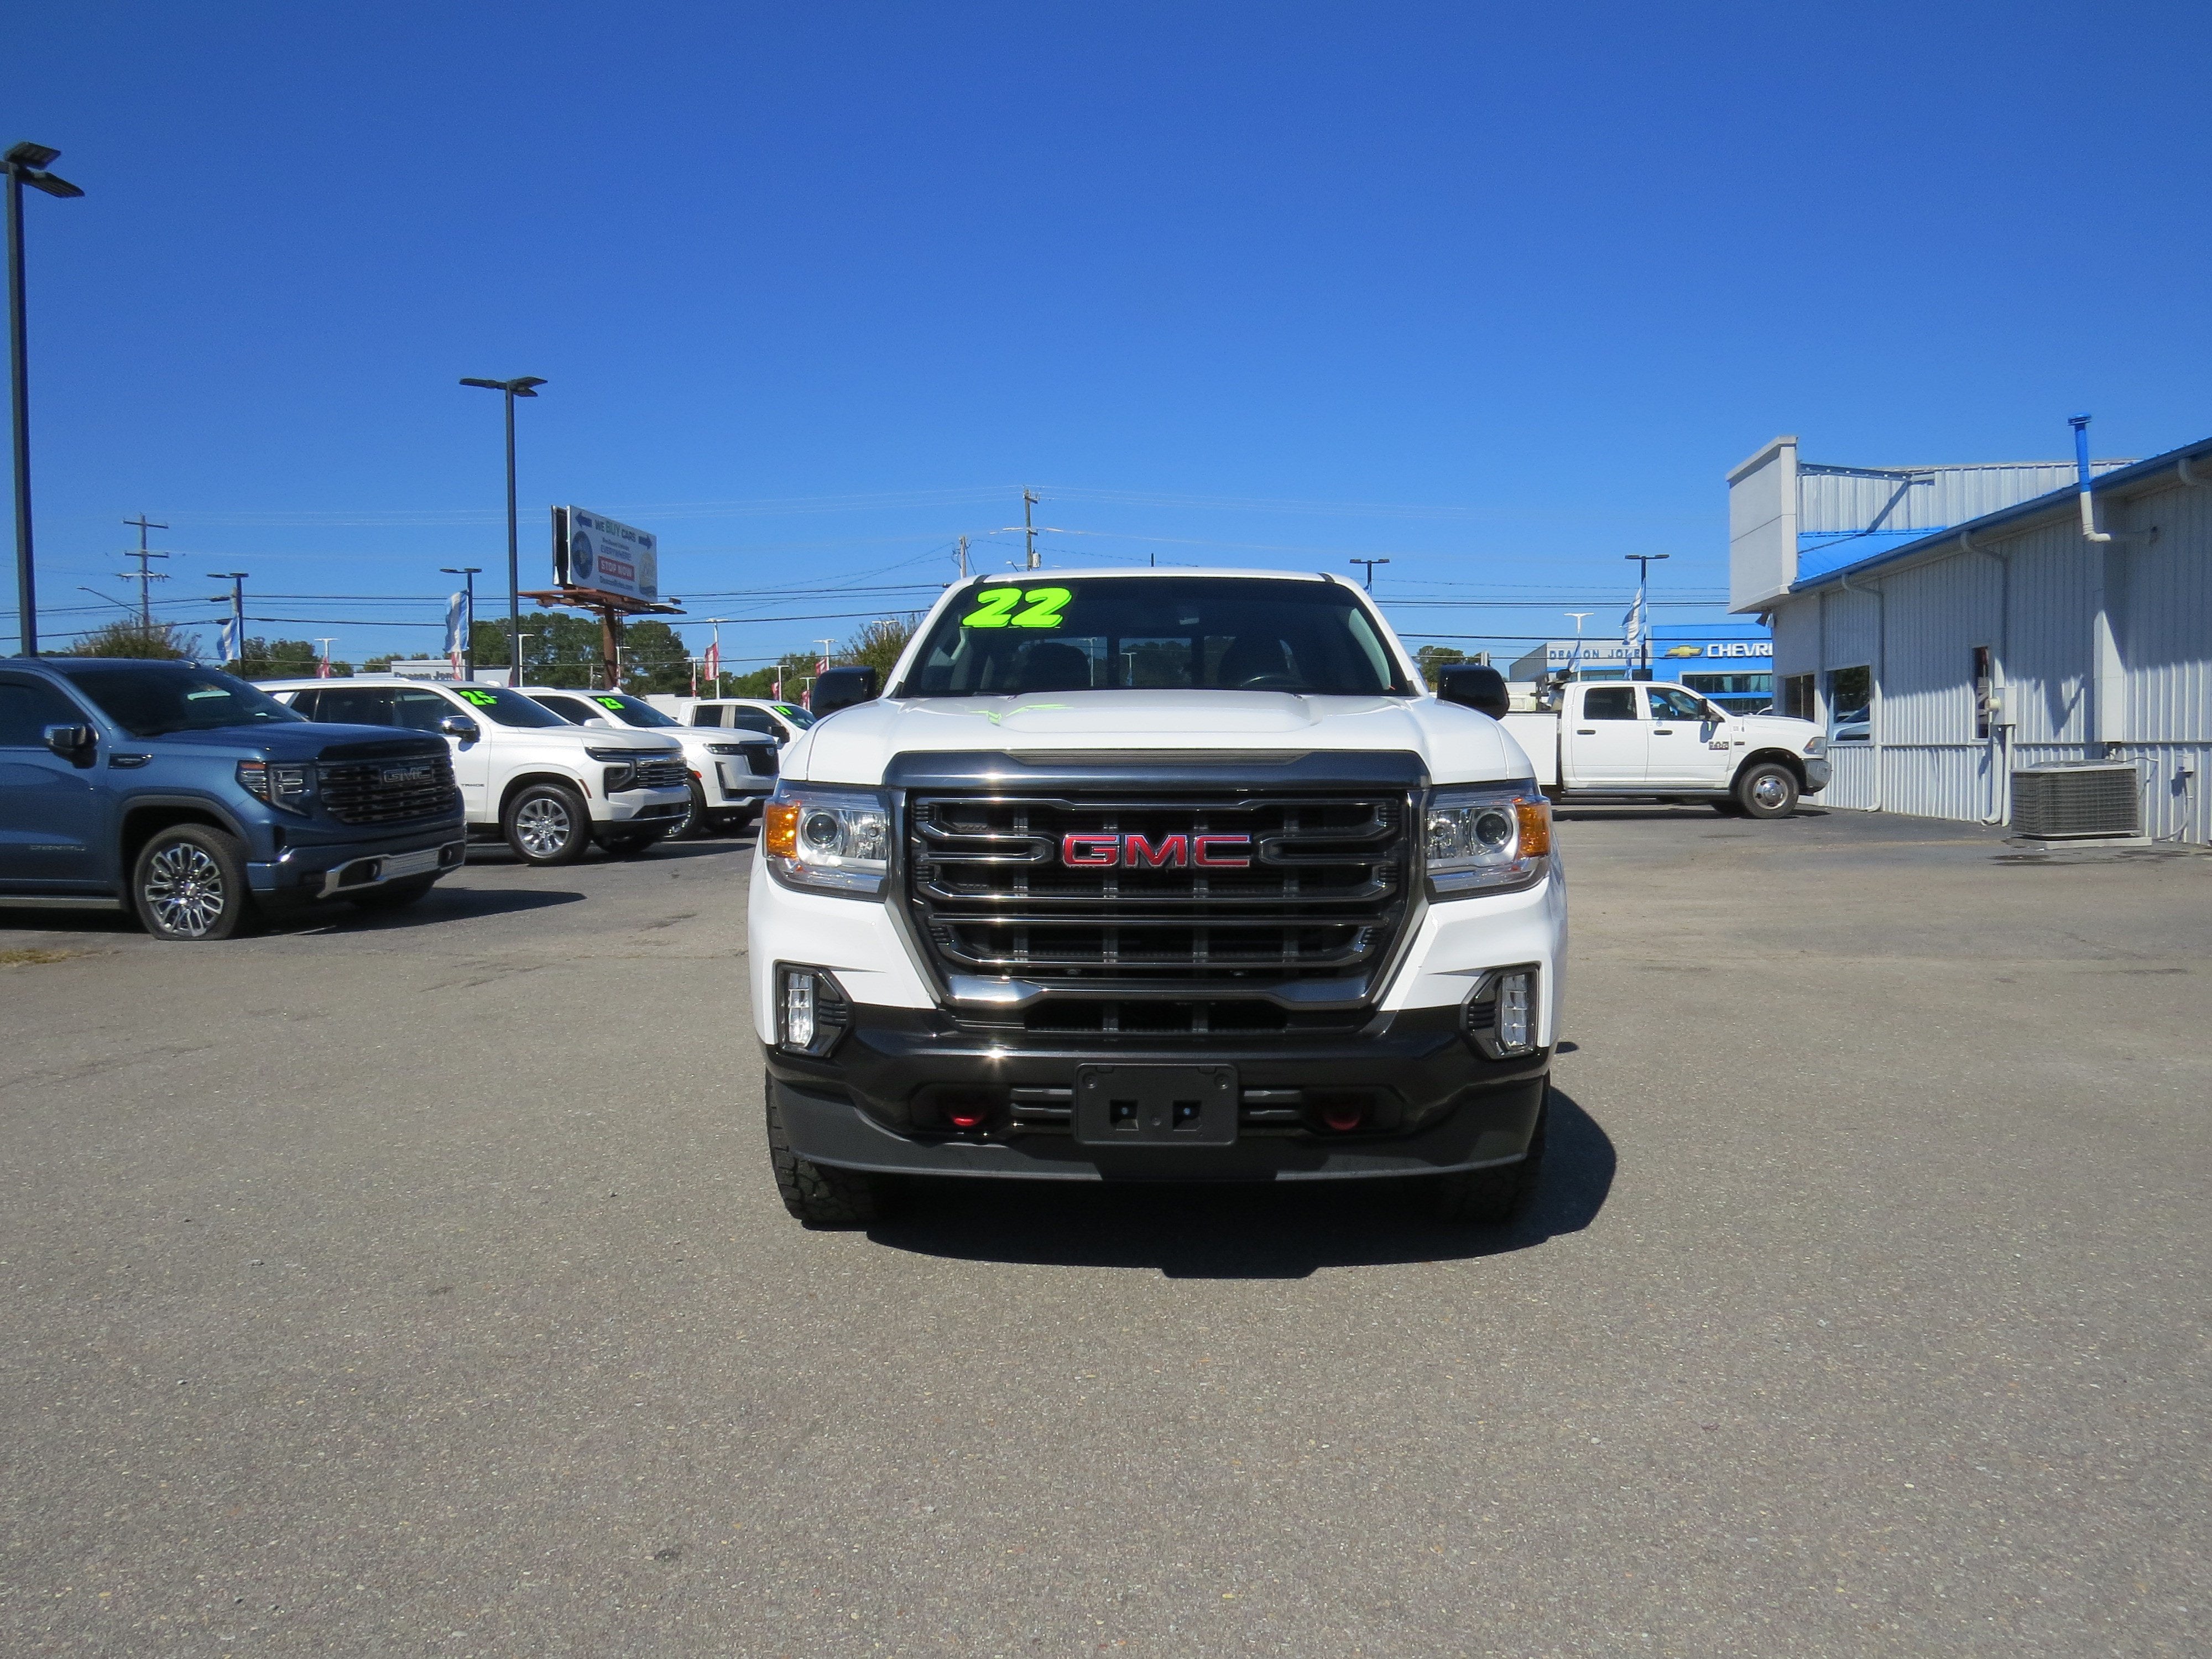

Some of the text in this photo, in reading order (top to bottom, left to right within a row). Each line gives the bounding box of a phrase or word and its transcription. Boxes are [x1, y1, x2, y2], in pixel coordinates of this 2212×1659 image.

[595, 520, 636, 542] WE BUY CARS
[601, 560, 617, 572] STOP
[962, 587, 1072, 628] 22
[1550, 649, 1599, 660] DEAON
[459, 690, 497, 706] 25
[596, 697, 626, 710] 23
[384, 766, 431, 782] GMC
[1062, 833, 1251, 867] GMC
